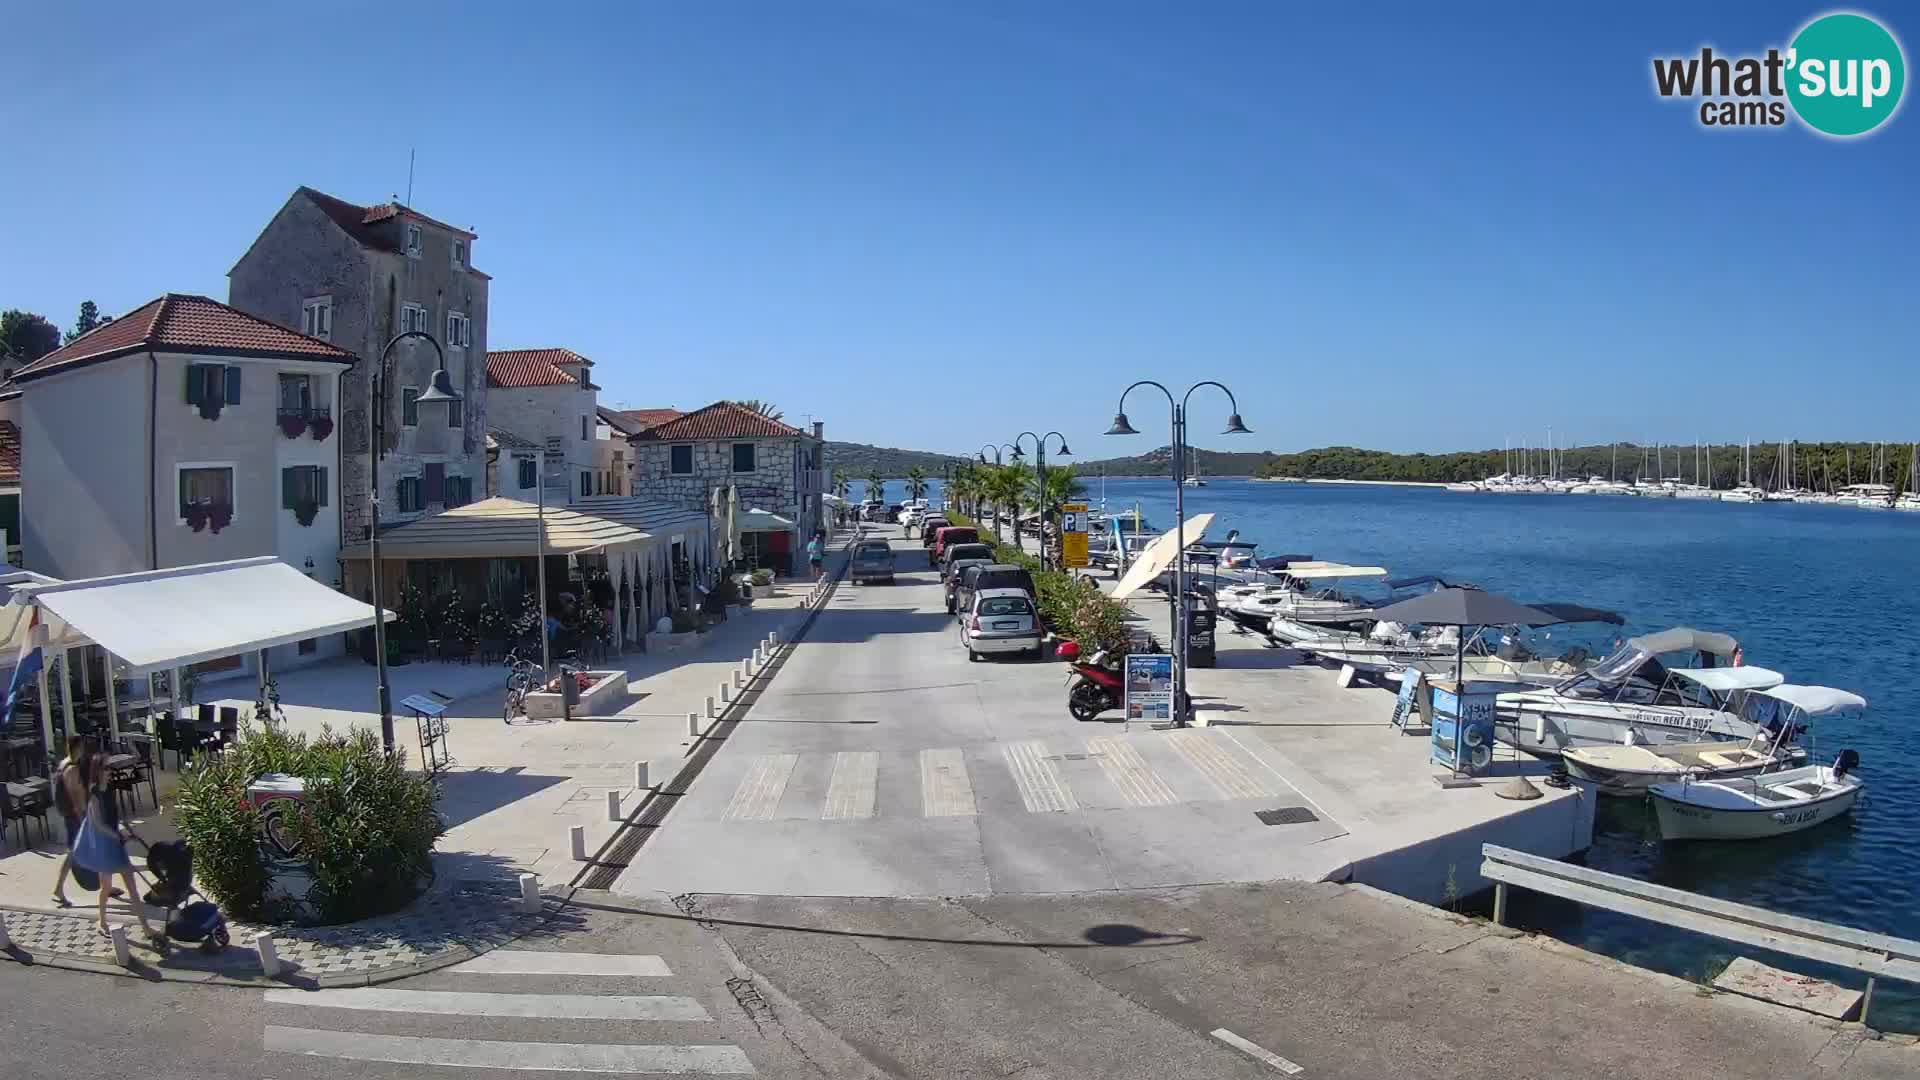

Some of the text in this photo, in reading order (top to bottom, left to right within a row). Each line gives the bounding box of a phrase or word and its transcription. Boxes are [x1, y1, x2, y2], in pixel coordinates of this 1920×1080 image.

[1064, 514, 1075, 530] P
[1663, 715, 1685, 727] RENT
[1685, 717, 1692, 728] A
